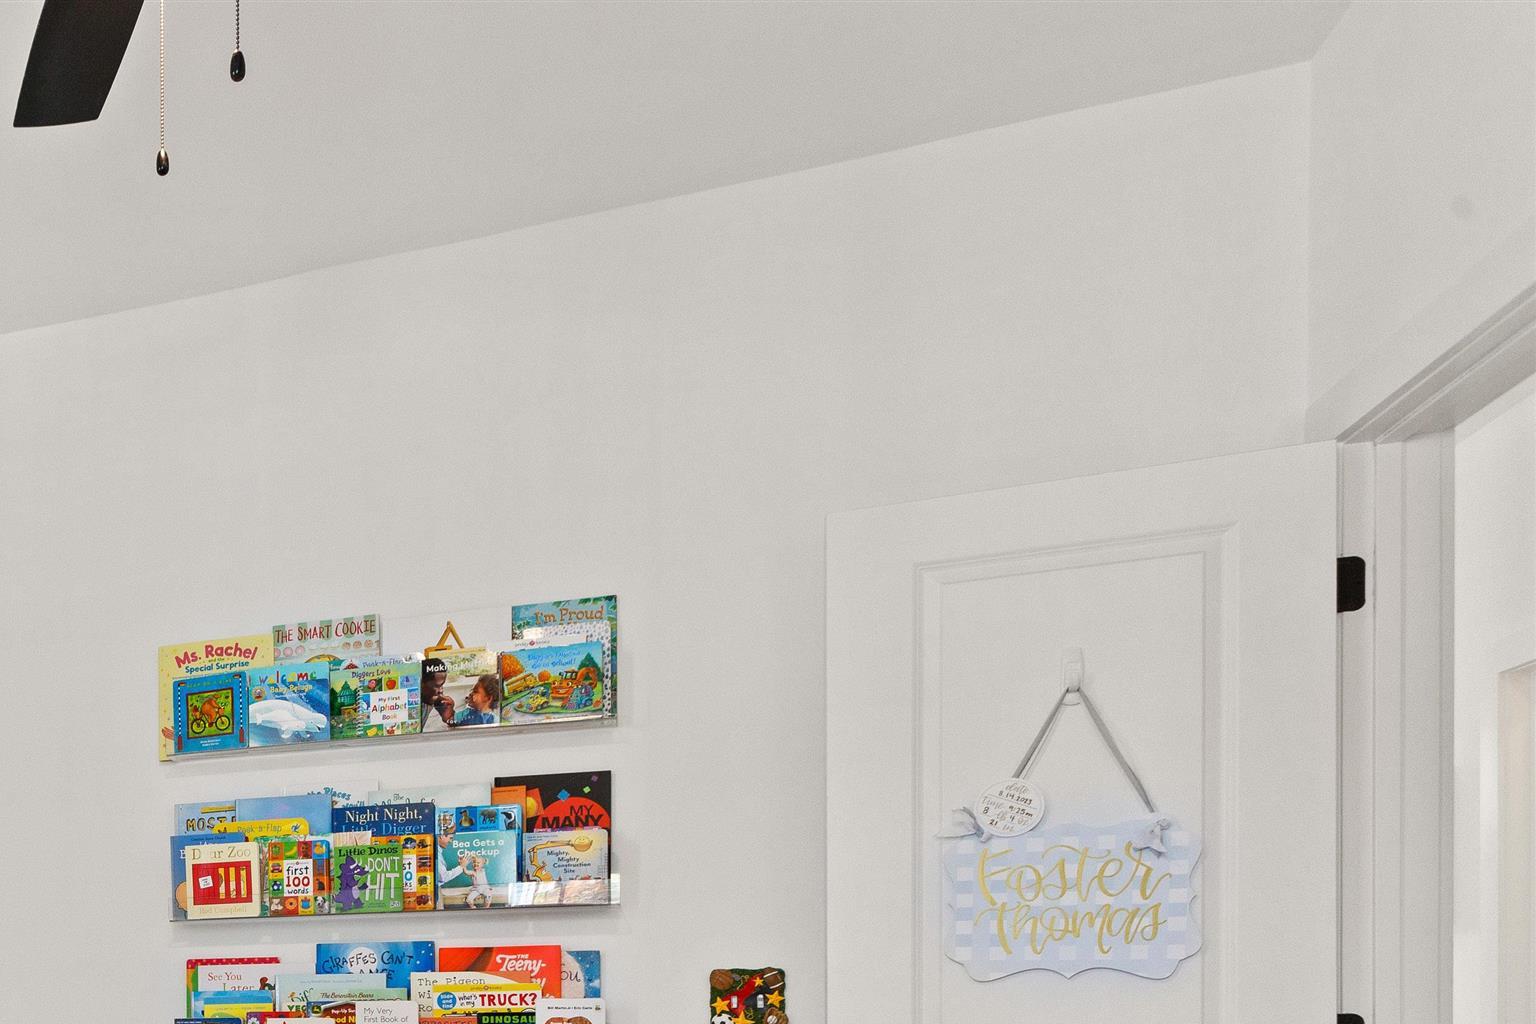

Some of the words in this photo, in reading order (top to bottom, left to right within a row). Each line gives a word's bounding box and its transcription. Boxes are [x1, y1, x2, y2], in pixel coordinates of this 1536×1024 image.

[535, 610, 556, 624] I'm
[559, 606, 604, 624] Proud
[275, 629, 293, 643] THE
[297, 624, 332, 641] SMART
[335, 620, 375, 637] COOKIE
[175, 651, 201, 668] Ms.
[204, 643, 258, 659] Rachel
[185, 663, 213, 674] Special
[216, 660, 250, 671] Surprise
[426, 664, 458, 673] Making
[351, 670, 375, 680] Diggers
[372, 702, 407, 713] Alphabet
[324, 787, 351, 800] Places
[345, 809, 379, 825] Night
[384, 806, 423, 822] Night,
[569, 804, 594, 816] MY
[541, 814, 604, 828] MANY
[382, 822, 426, 835] Digger
[452, 840, 471, 848] Bea
[473, 839, 496, 848] Gets
[227, 846, 251, 858] Zoo
[338, 847, 365, 858] Little
[368, 846, 398, 856] Dinos
[457, 849, 500, 858] Checkup
[286, 865, 310, 875] first
[367, 857, 400, 872] DON'T
[978, 841, 1172, 907] Foster
[285, 876, 311, 888] 100
[365, 873, 400, 900] HIT
[321, 952, 377, 974] GIRAFFES
[381, 950, 414, 965] CAN'T
[496, 954, 547, 976] Teeny-
[207, 972, 223, 981] See
[224, 972, 242, 981] You
[417, 978, 438, 986] The
[446, 977, 486, 985] Pigeon
[479, 993, 537, 1007] TRUCK?
[364, 1008, 375, 1016] My
[482, 1015, 535, 1024] DINOSAU
